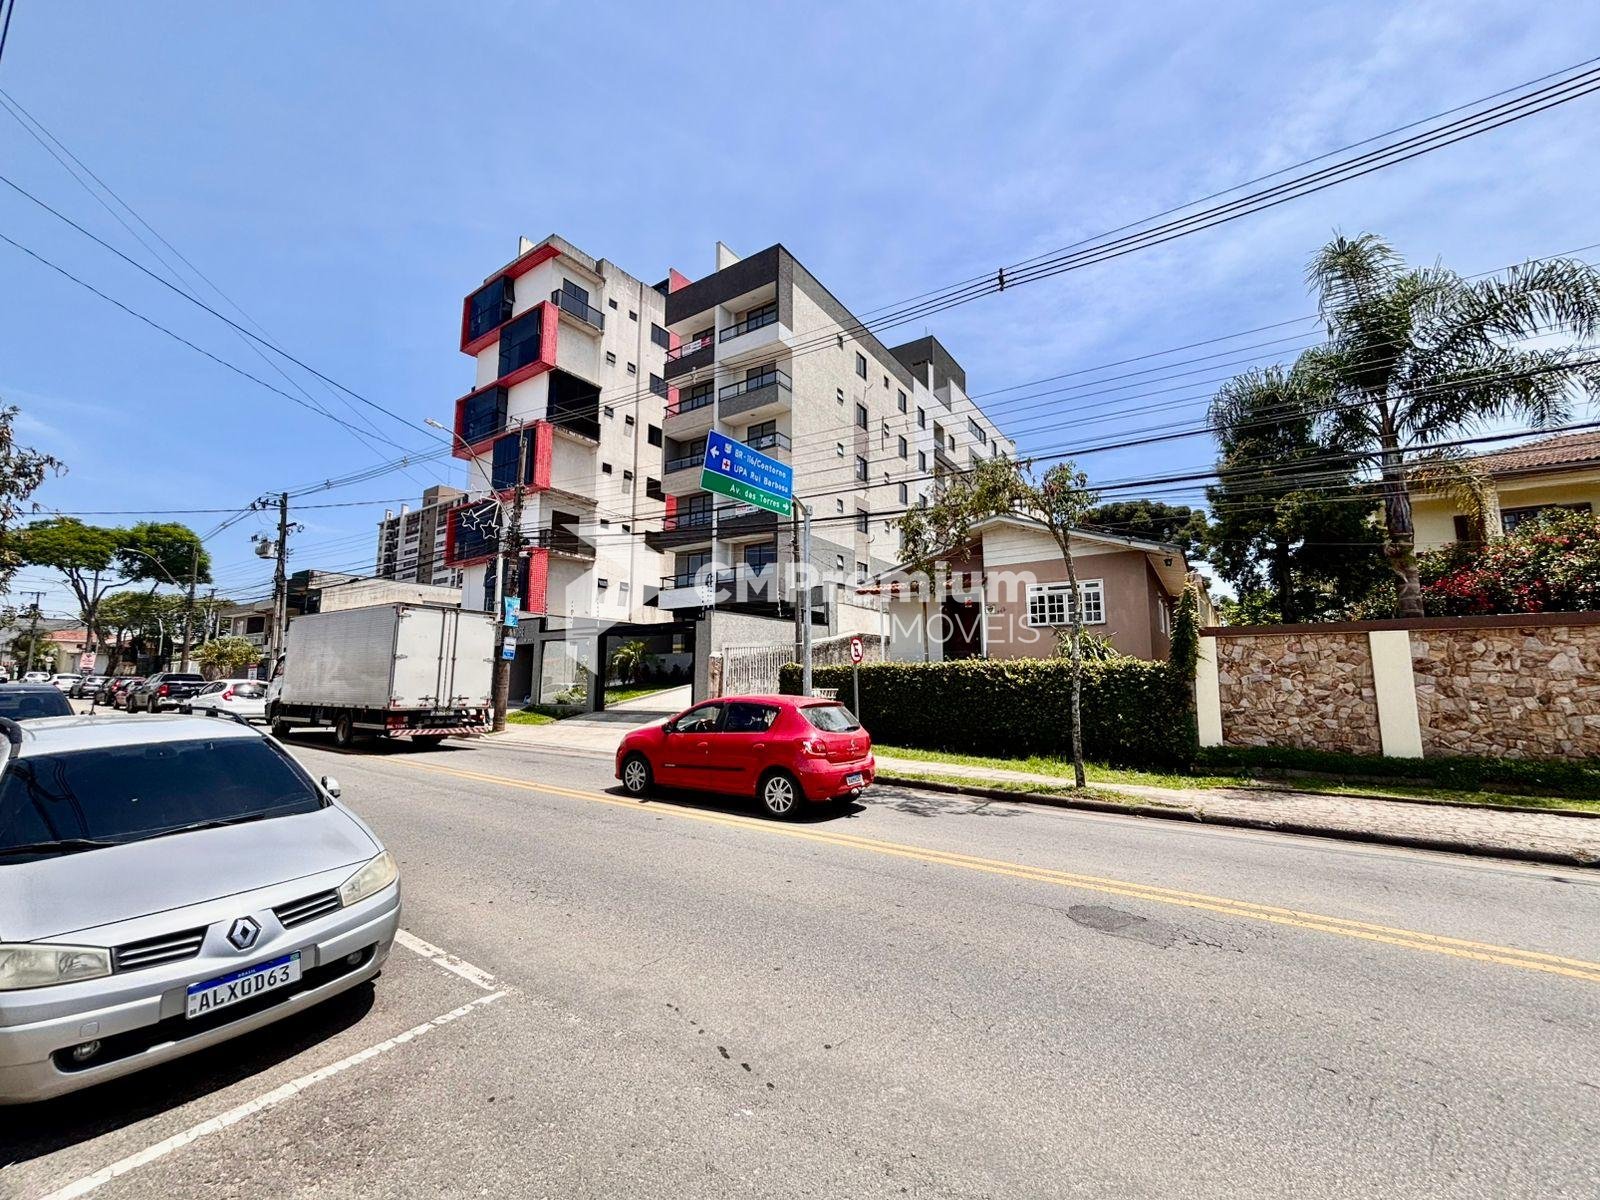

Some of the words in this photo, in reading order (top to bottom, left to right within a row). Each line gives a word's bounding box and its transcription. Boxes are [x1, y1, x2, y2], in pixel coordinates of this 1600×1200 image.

[734, 464, 747, 477] UPA
[750, 471, 761, 483] Rui
[764, 477, 788, 493] Barbosa
[730, 484, 741, 494] Av.
[744, 489, 756, 500] das
[760, 494, 780, 508] Torres
